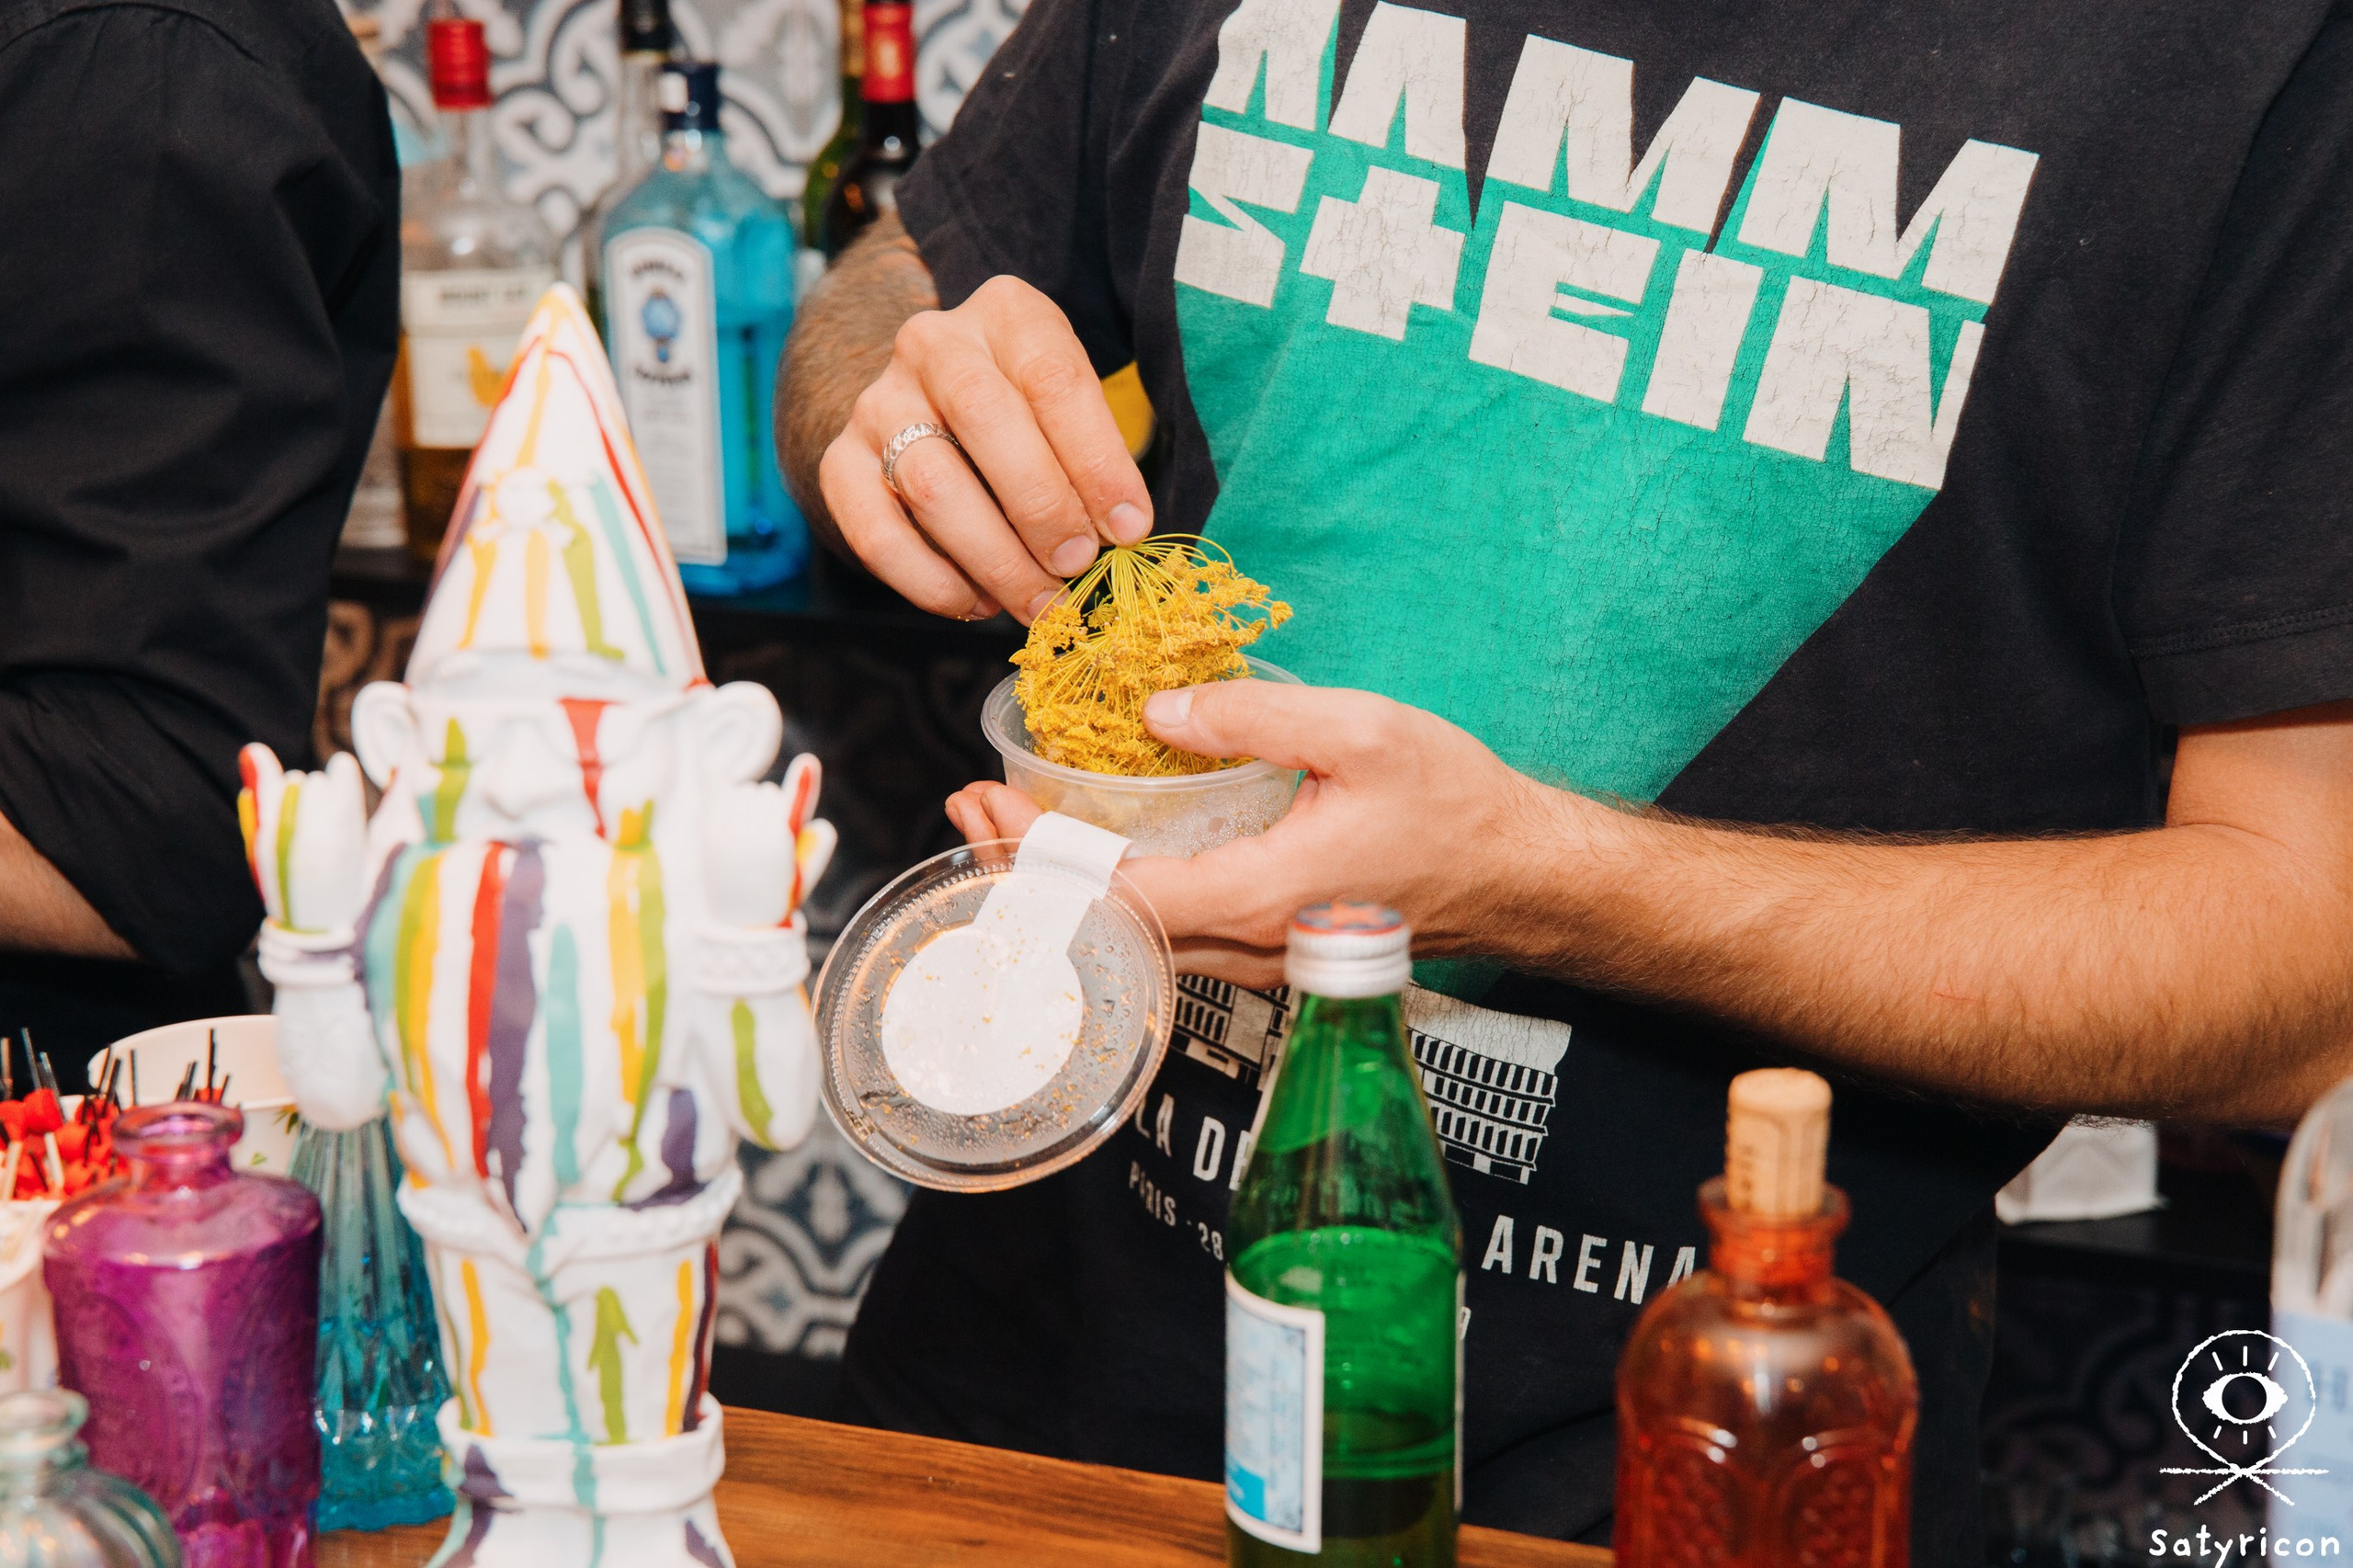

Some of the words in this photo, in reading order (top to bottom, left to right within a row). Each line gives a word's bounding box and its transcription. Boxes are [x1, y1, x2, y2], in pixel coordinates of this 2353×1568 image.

[1202, 0, 2040, 305] RAMM
[1174, 120, 1986, 492] STEIN
[1198, 1221, 1224, 1261] 28
[1481, 1214, 1696, 1305] ARENA
